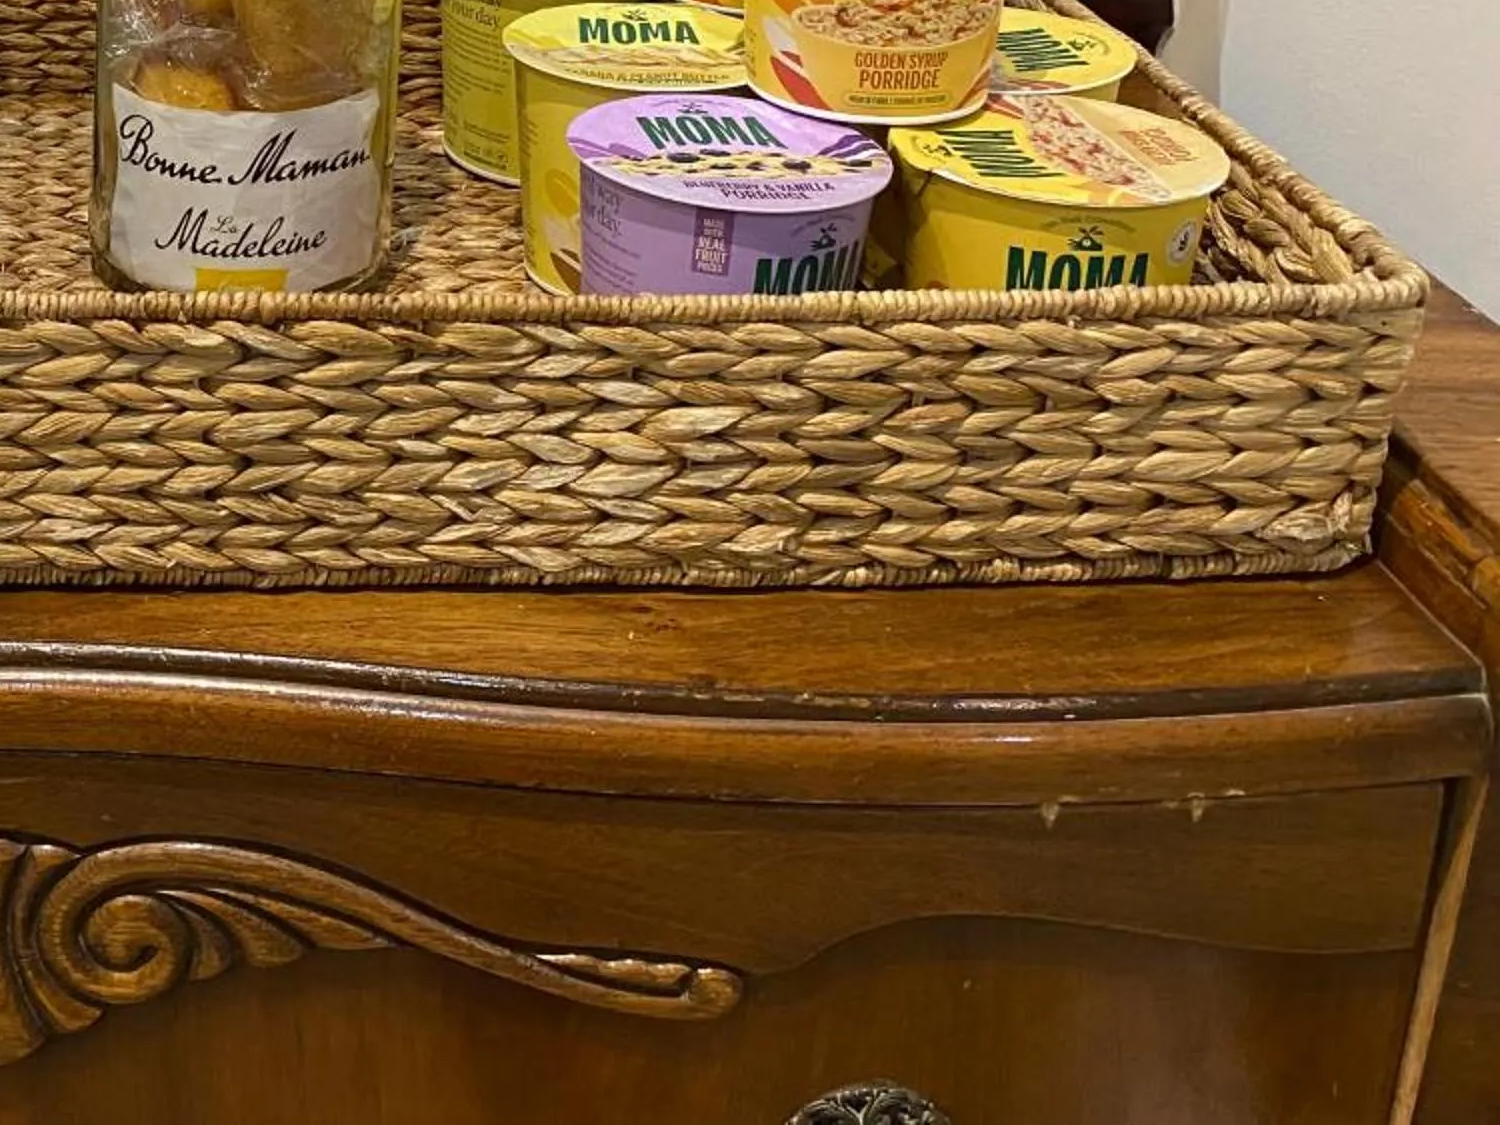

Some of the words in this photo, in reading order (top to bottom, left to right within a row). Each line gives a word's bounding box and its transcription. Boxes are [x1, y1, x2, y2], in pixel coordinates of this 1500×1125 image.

[579, 16, 698, 44] MOMA
[854, 52, 906, 69] GOLDEN
[910, 52, 948, 69] SYRUP
[858, 69, 941, 90] PORRIDGE
[636, 115, 788, 150] MOMA
[120, 114, 222, 185] Bonne
[228, 127, 370, 186] Maman
[154, 206, 328, 259] Madeleine
[210, 215, 238, 234] La
[695, 249, 728, 265] FRUIT
